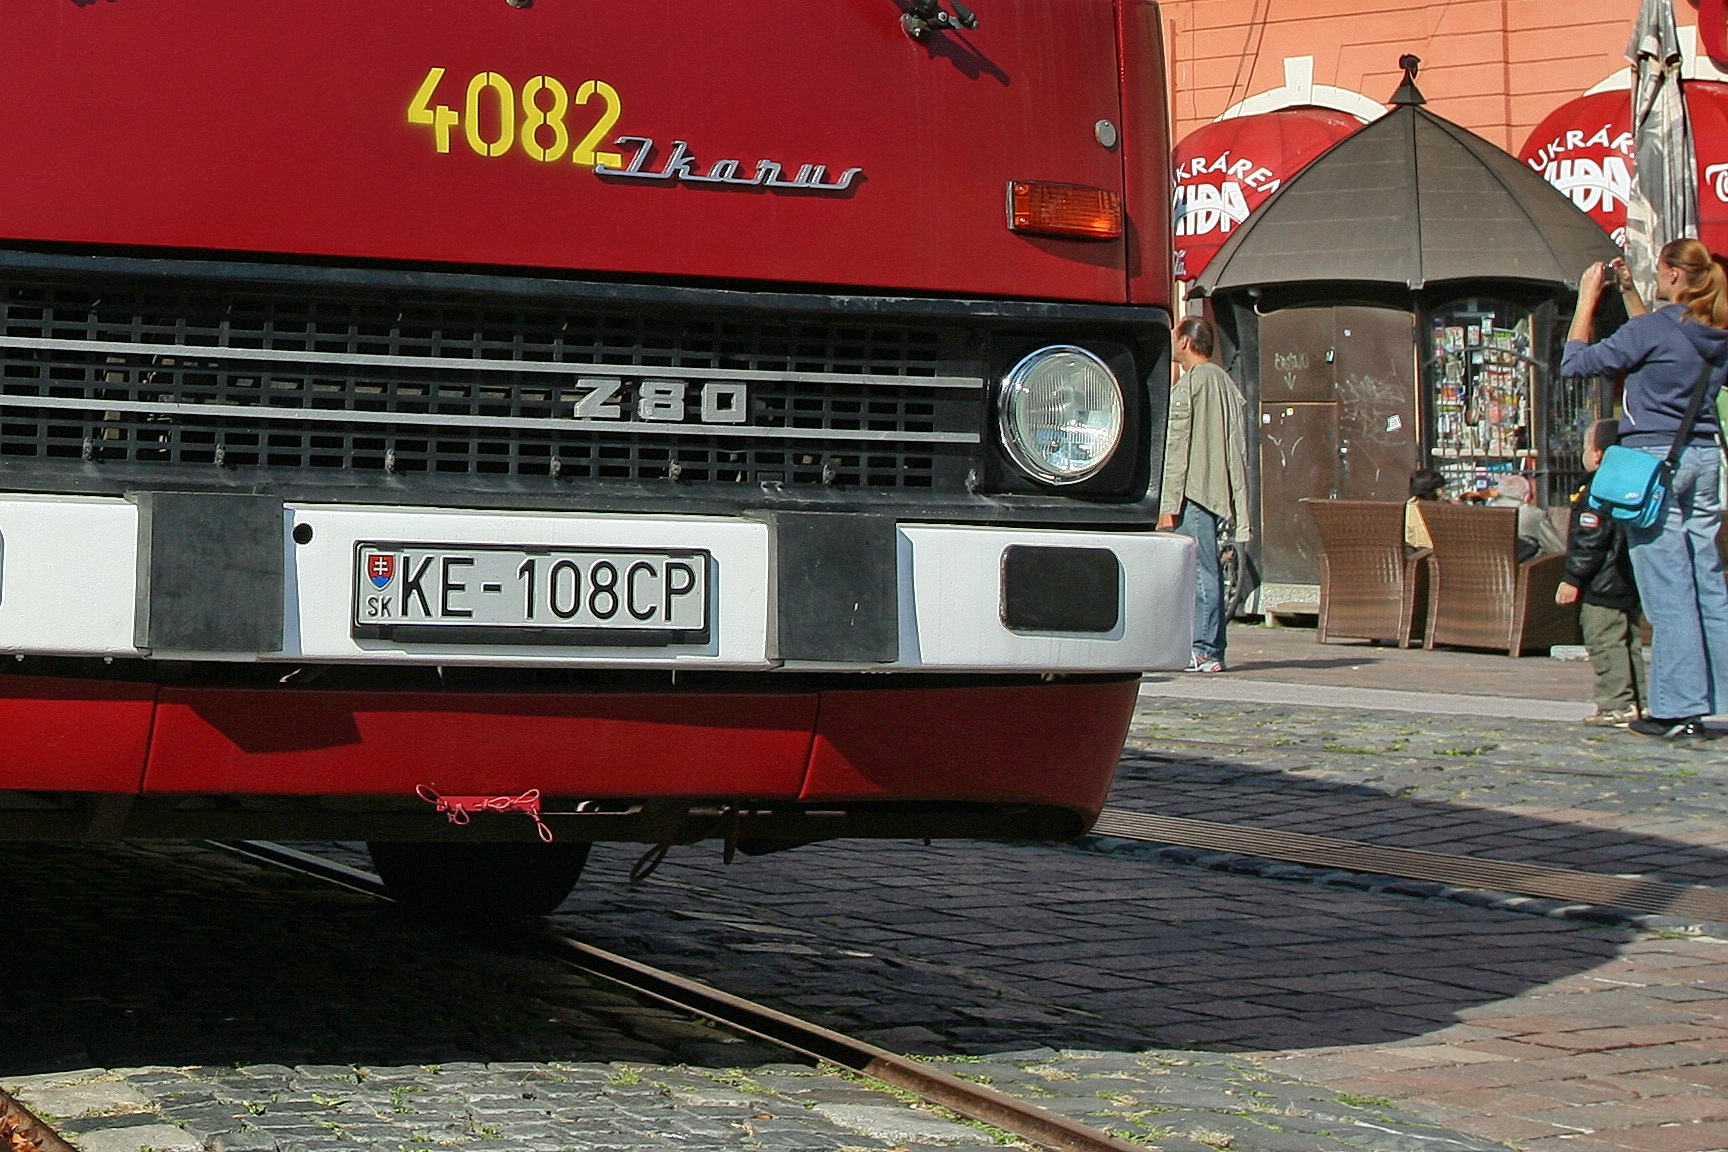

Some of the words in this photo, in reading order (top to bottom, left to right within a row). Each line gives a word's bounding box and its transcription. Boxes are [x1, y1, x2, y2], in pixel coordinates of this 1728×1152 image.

[407, 66, 623, 168] 4082
[592, 135, 864, 191] Ikarus
[365, 595, 393, 618] SK
[399, 553, 697, 624] KE-108CP
